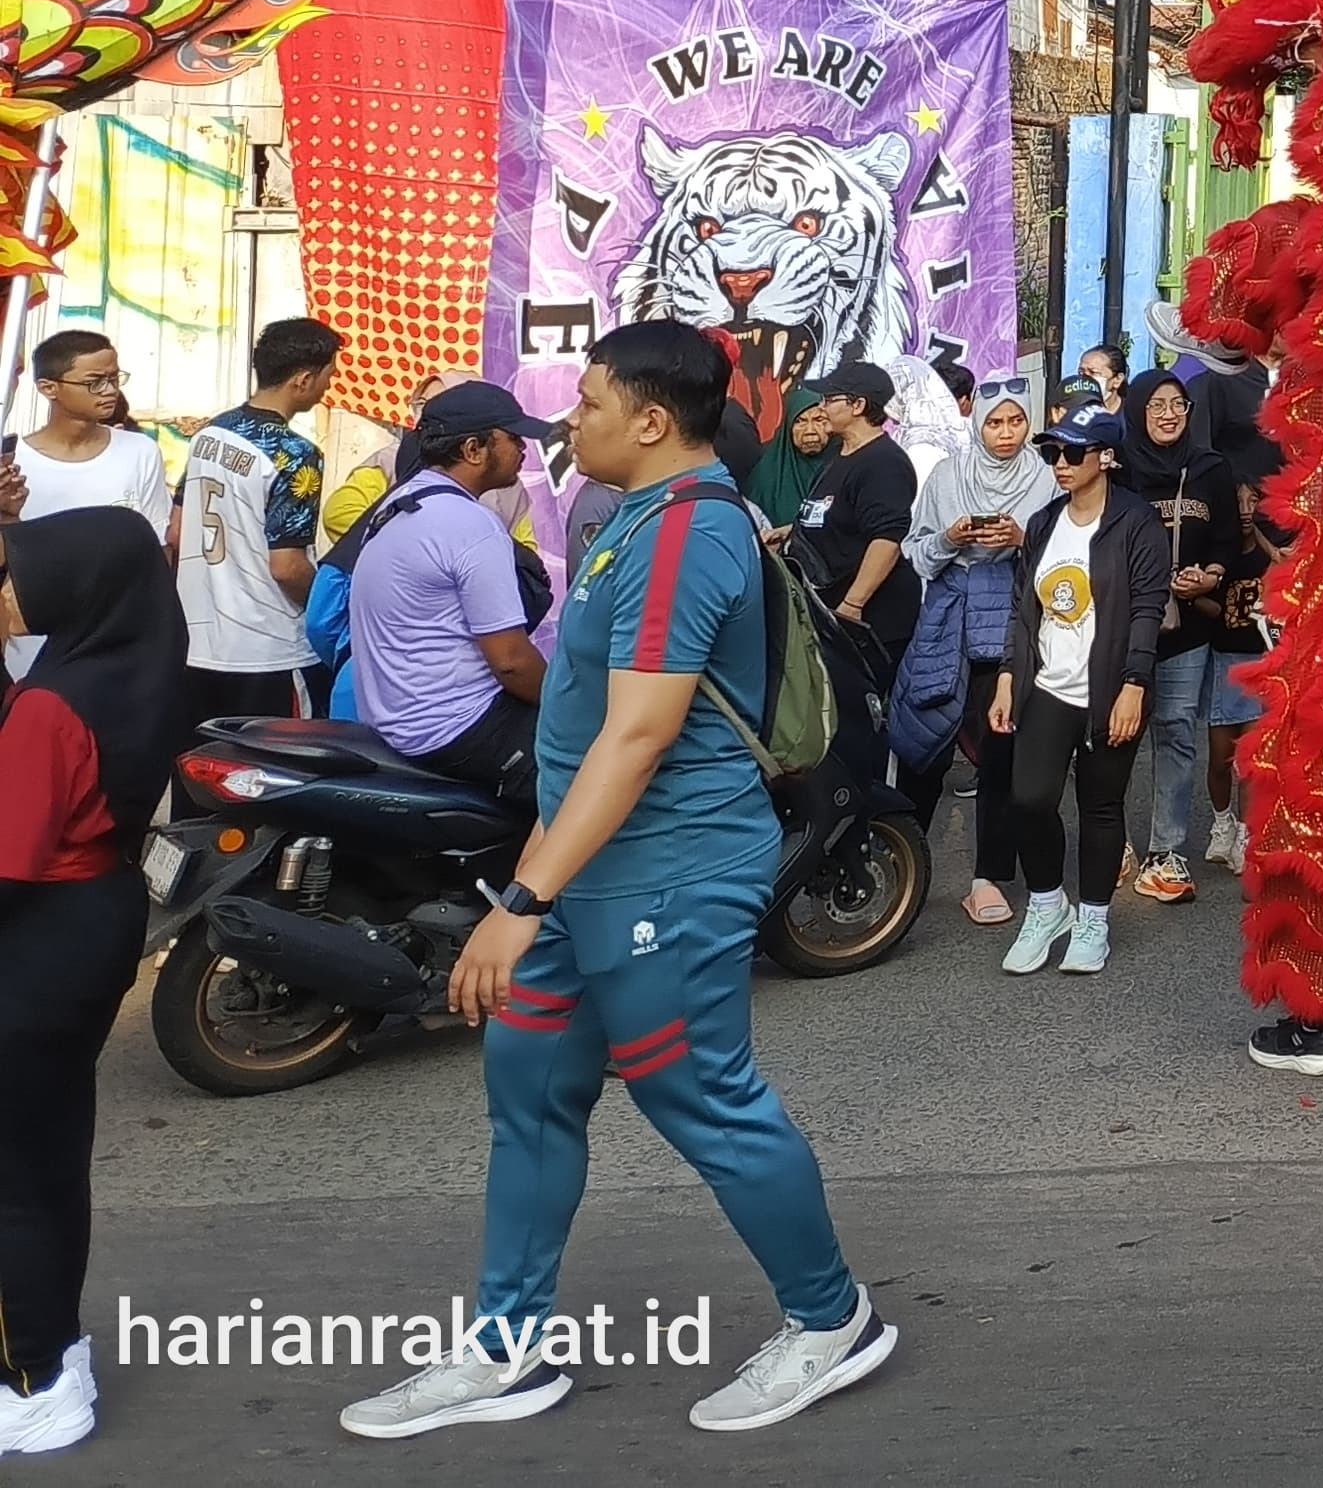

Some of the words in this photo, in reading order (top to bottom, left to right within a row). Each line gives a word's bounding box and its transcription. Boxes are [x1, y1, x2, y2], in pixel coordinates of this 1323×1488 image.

[651, 30, 754, 102] WE
[773, 30, 885, 107] ARE
[200, 476, 225, 566] 5
